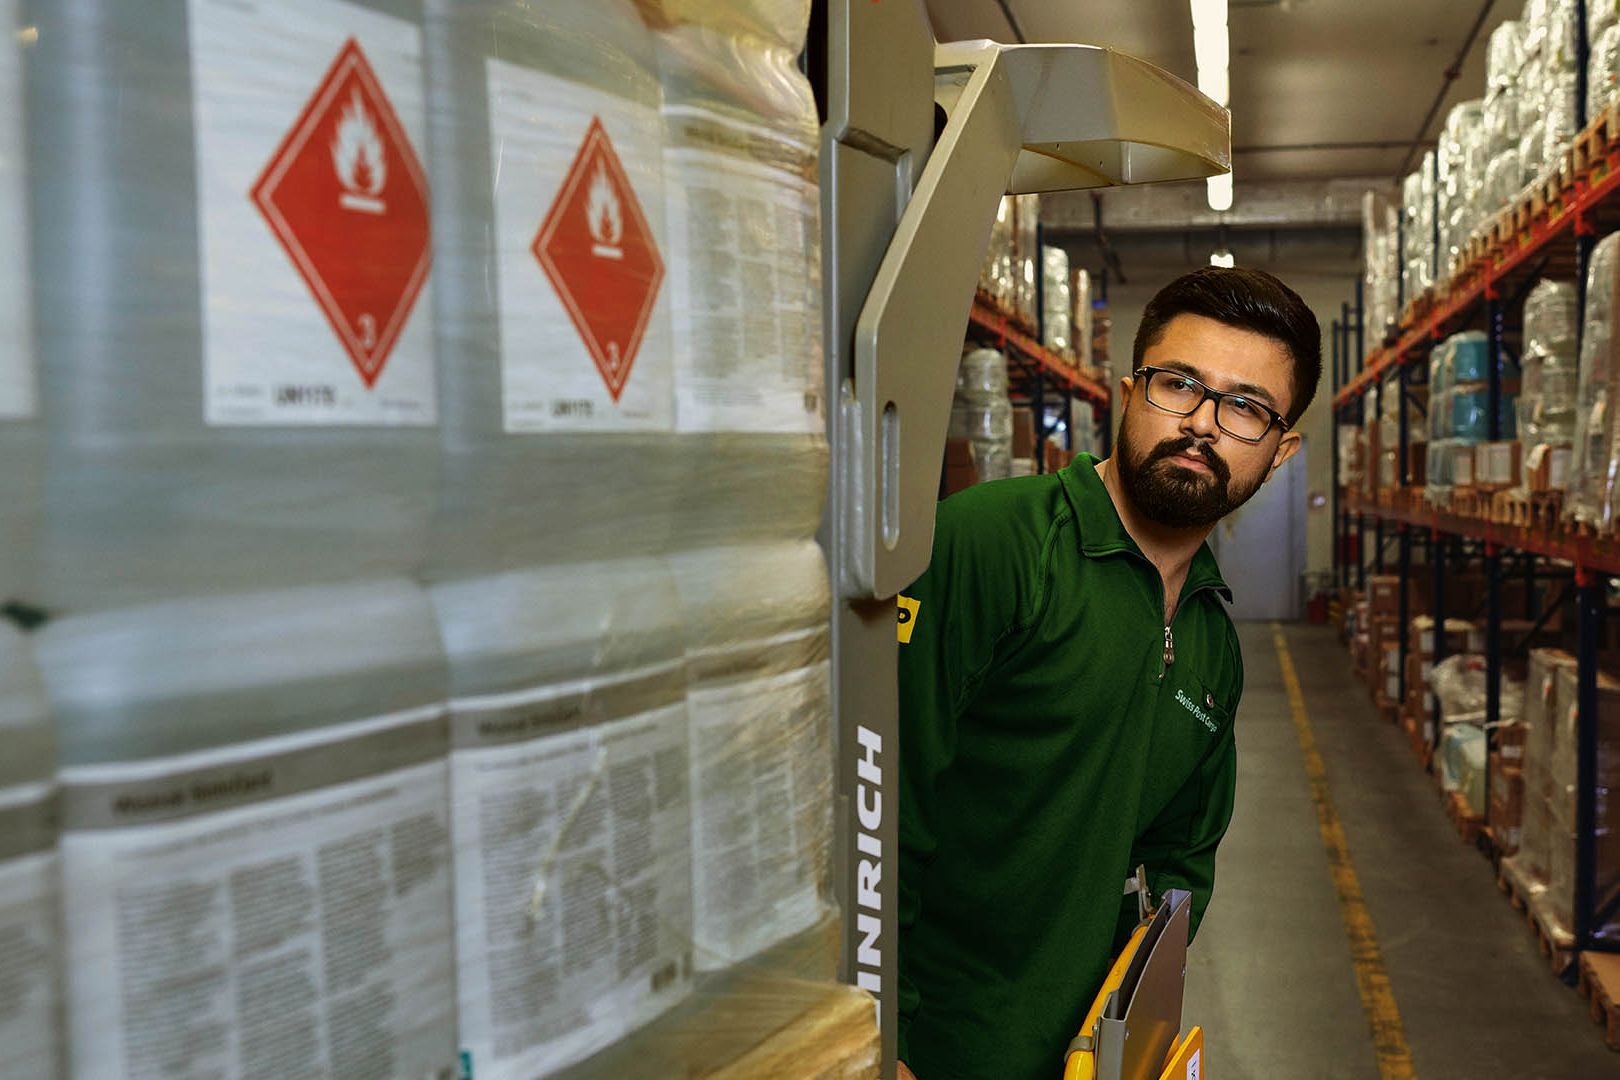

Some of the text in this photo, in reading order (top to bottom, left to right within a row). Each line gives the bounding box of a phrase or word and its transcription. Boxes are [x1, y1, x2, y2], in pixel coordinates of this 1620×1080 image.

[357, 313, 376, 347] 3
[606, 341, 620, 369] 3
[1174, 689, 1196, 712] Swiss
[1193, 705, 1207, 723] Post
[857, 725, 882, 1033] INRICH
